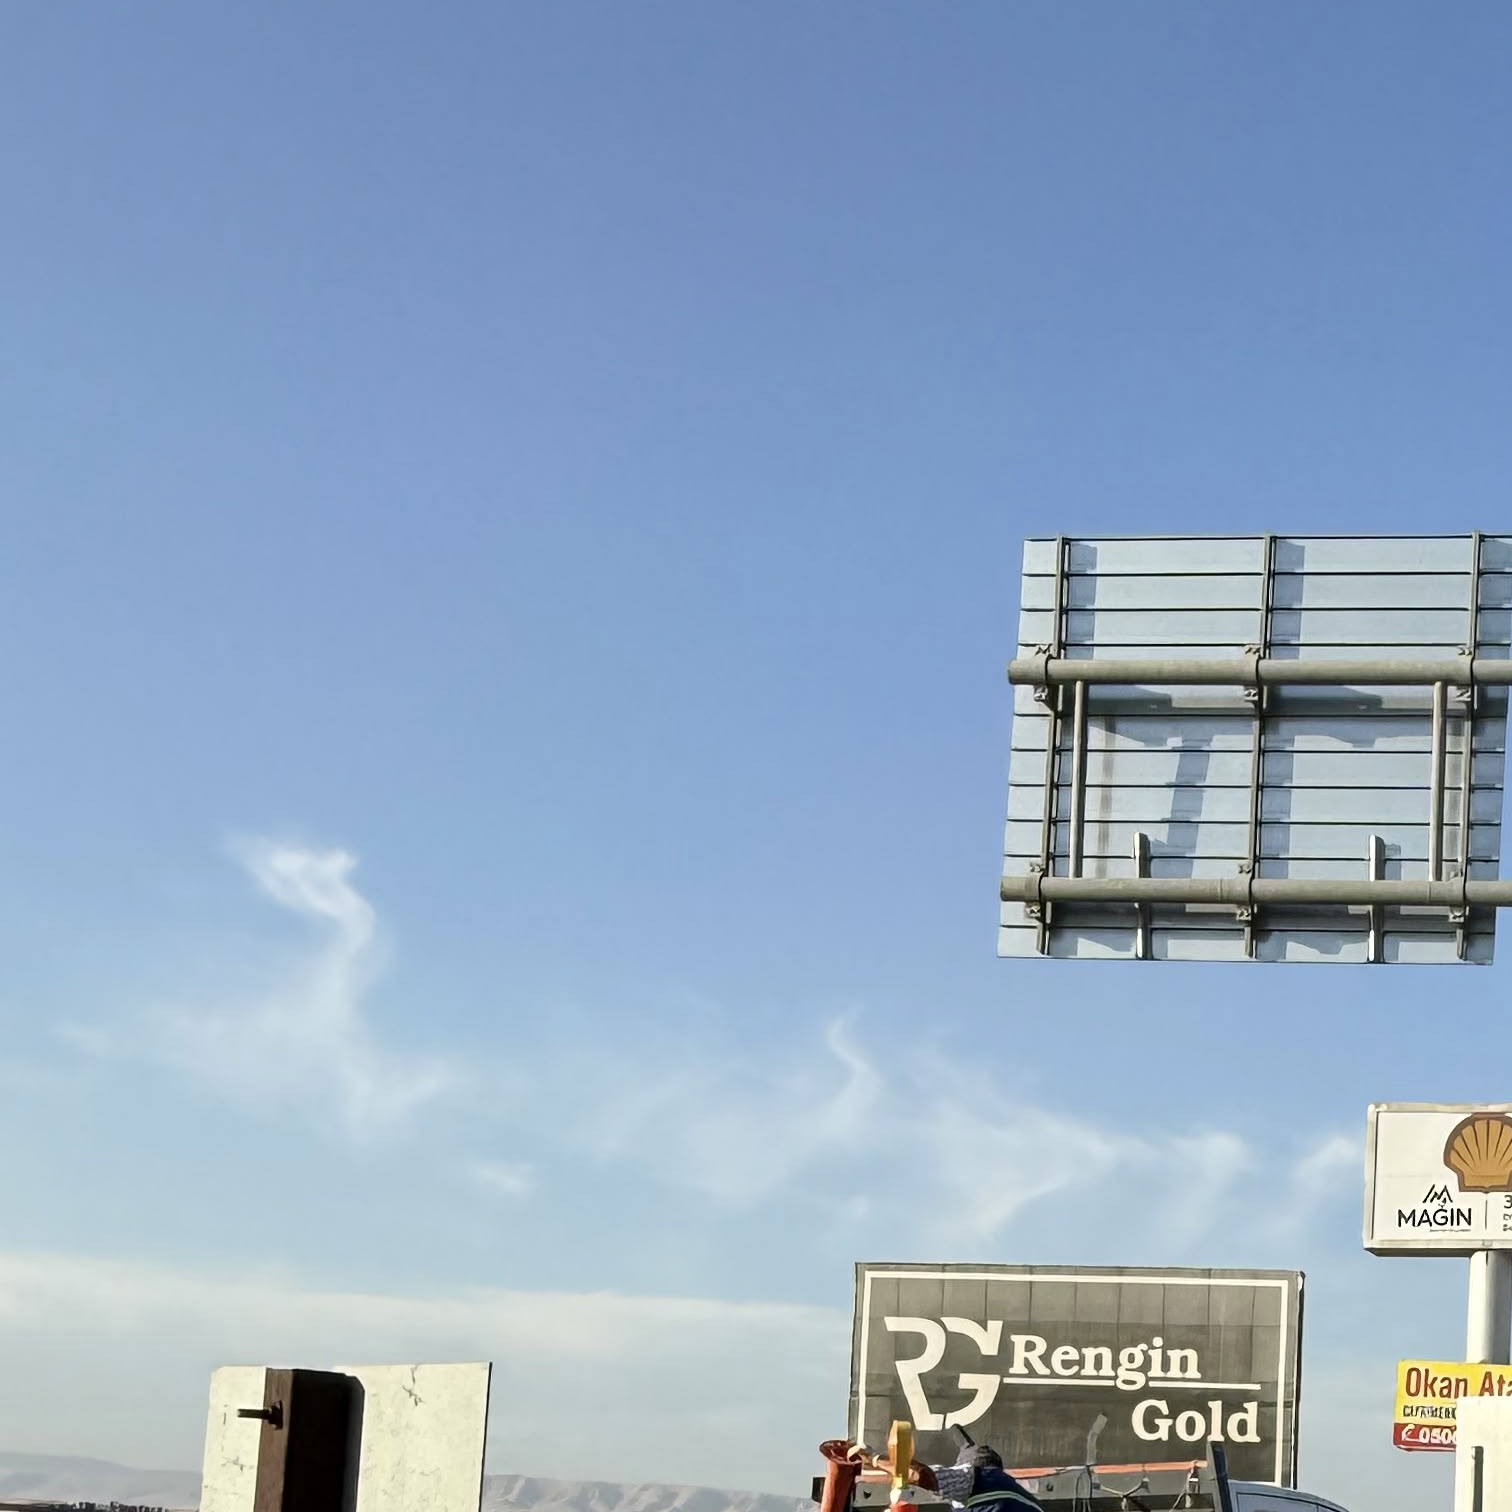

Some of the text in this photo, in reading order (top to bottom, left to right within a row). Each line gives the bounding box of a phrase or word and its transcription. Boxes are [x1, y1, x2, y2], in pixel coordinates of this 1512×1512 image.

[1504, 1194, 1512, 1209] 3
[1008, 1334, 1201, 1390] Rengin
[1405, 1367, 1468, 1399] Okan
[1131, 1399, 1260, 1443] Gold
